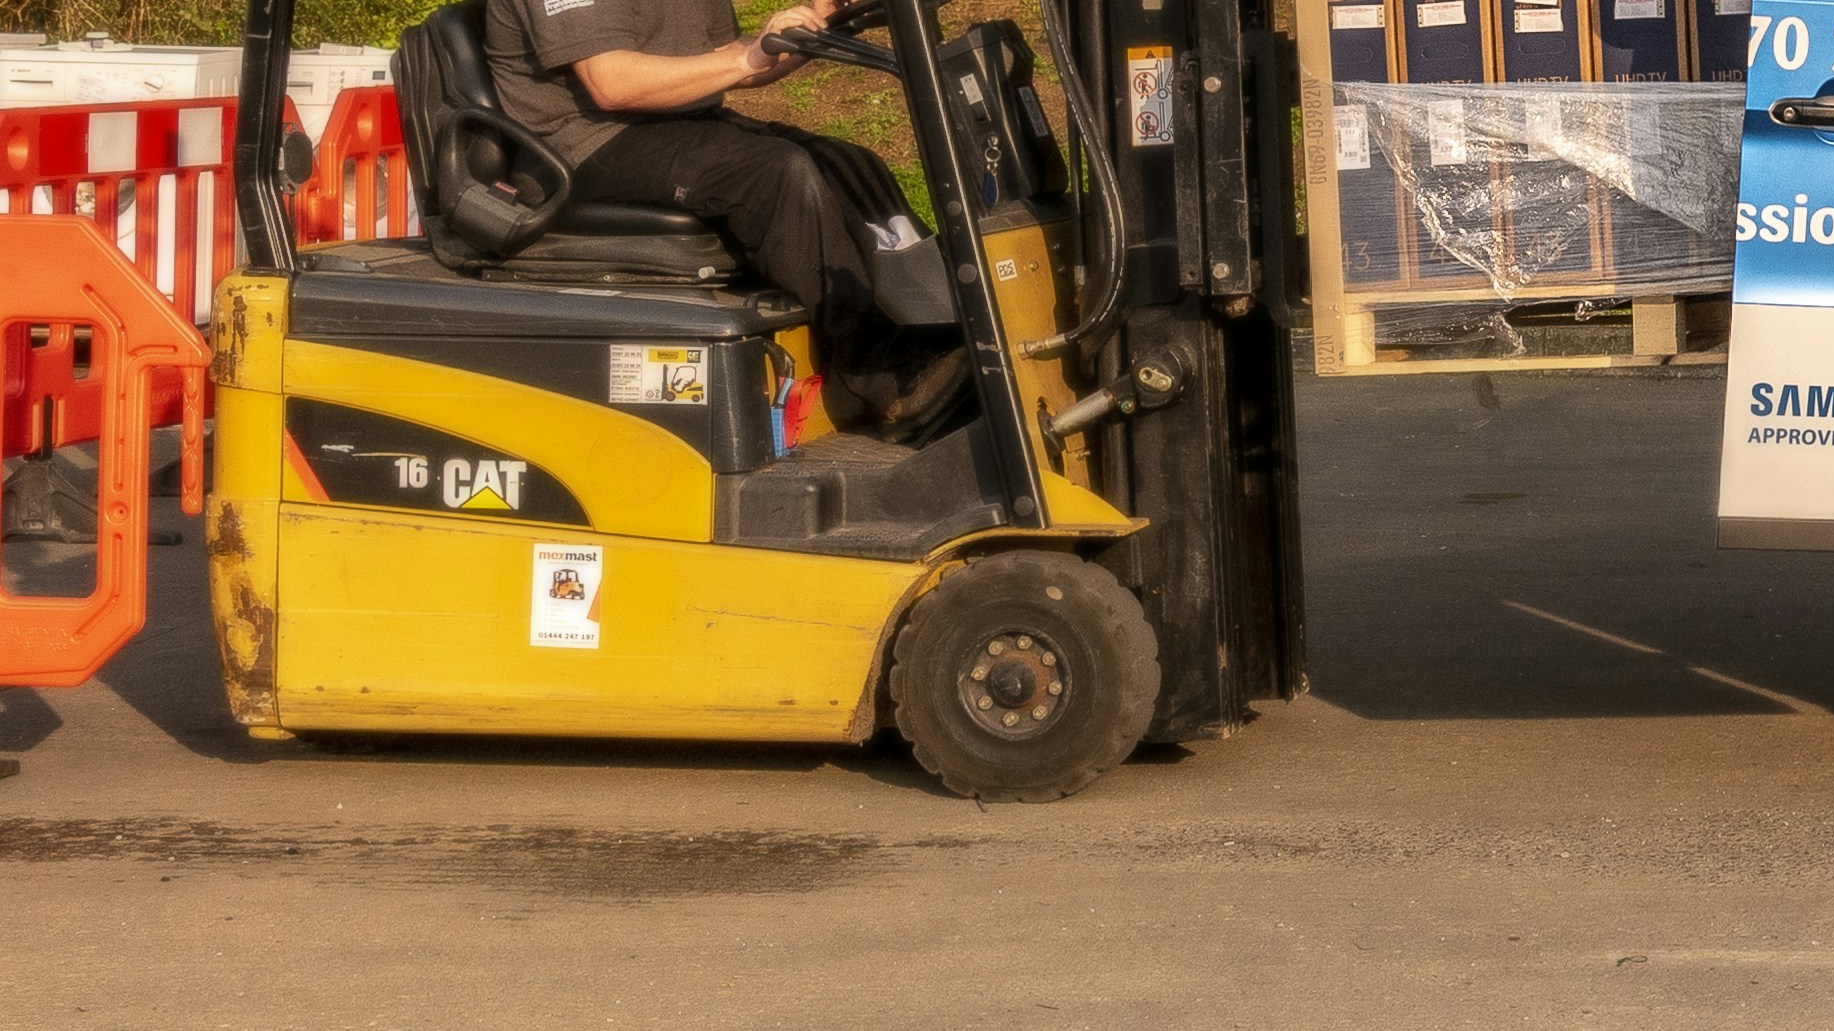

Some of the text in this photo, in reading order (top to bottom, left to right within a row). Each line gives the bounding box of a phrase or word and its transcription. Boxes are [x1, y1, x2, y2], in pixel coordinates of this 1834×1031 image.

[1749, 16, 1809, 70] 70
[395, 458, 526, 510] 16 CAT
[539, 551, 597, 562] mexmast
